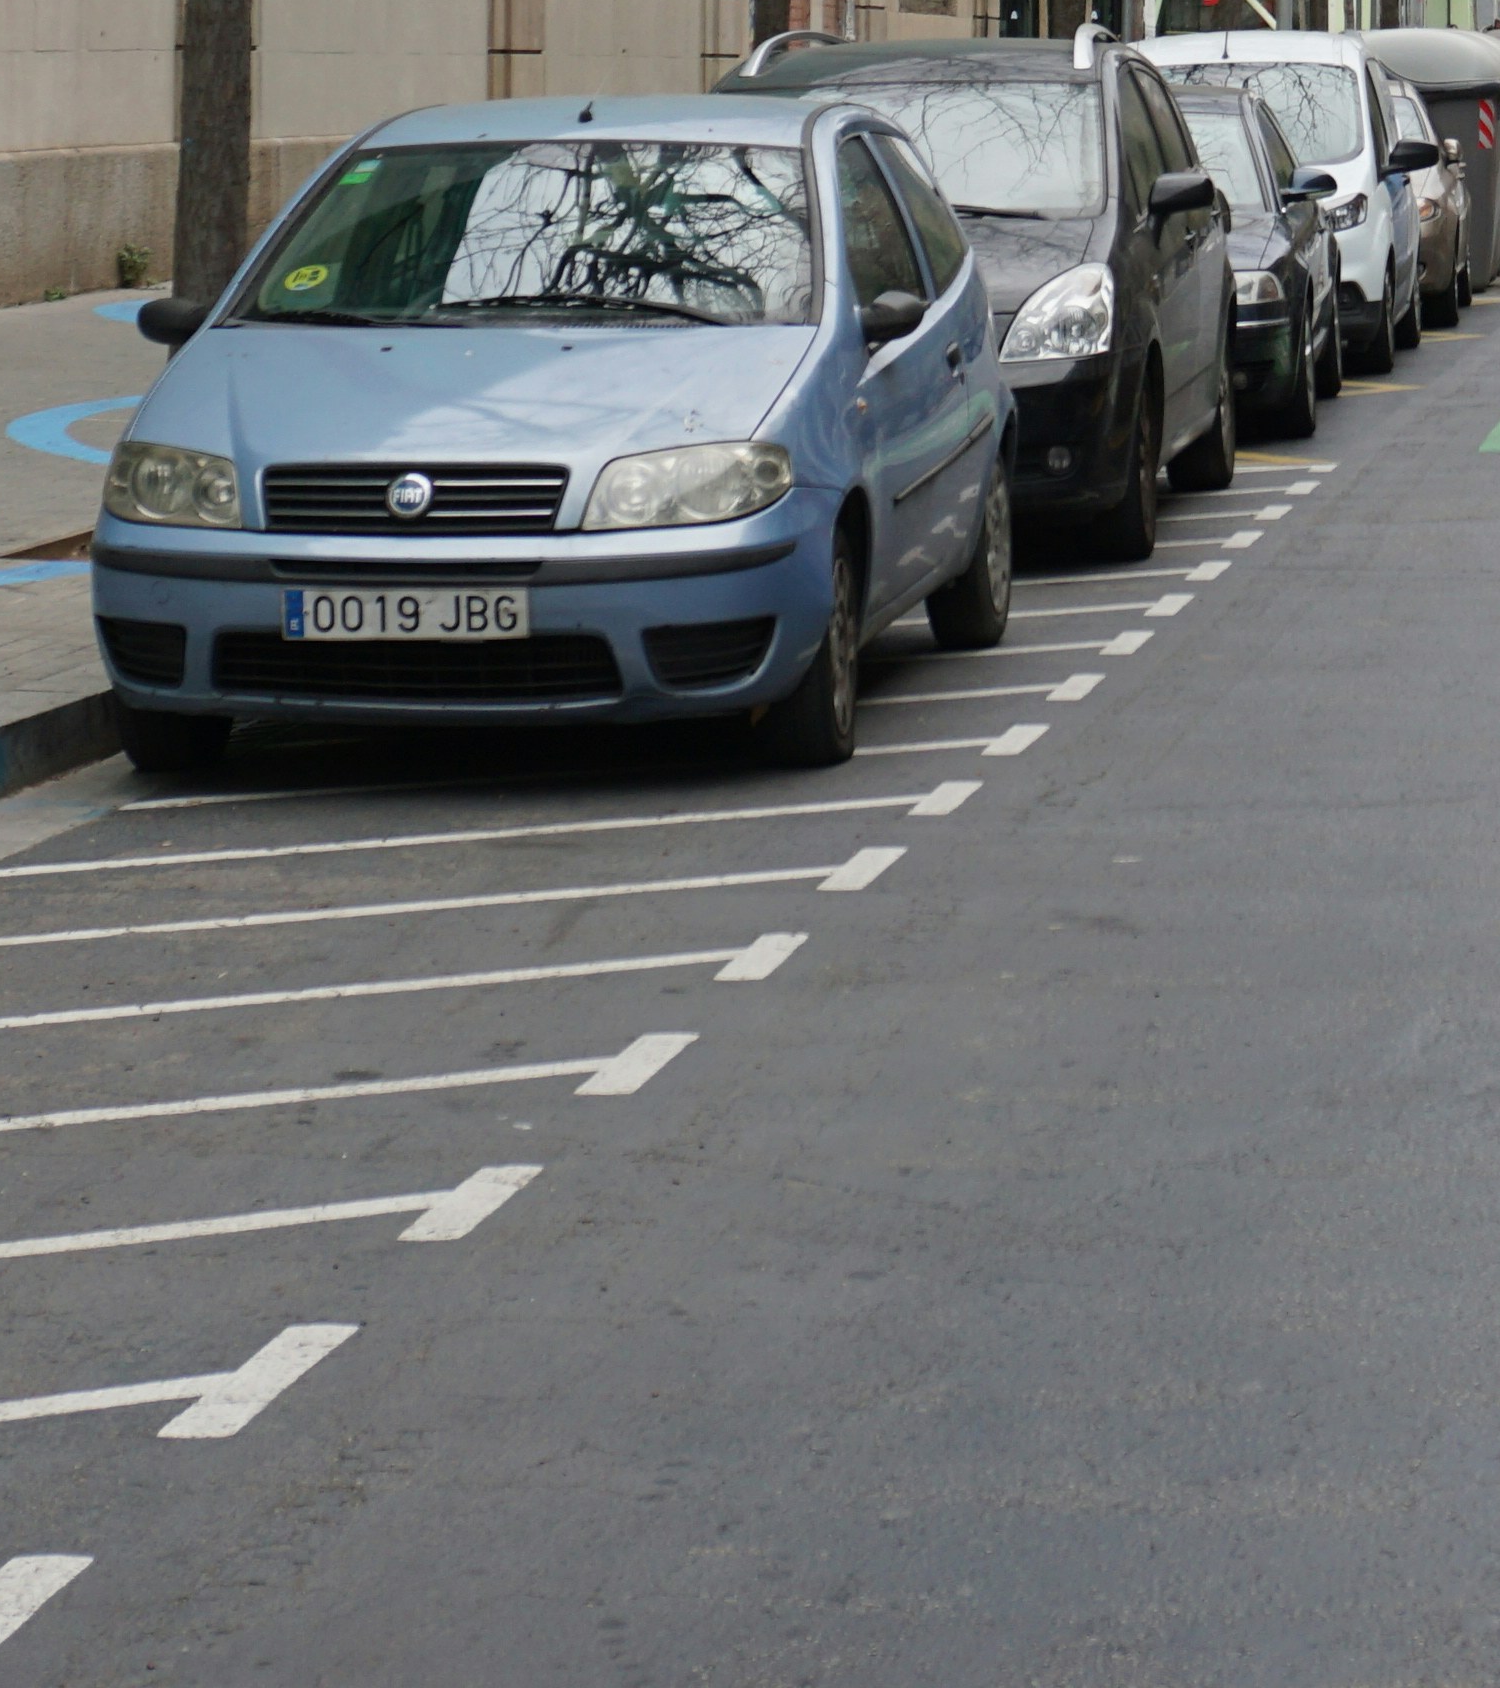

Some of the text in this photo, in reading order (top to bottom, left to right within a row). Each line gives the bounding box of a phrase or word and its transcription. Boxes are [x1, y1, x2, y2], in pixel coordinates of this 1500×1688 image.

[392, 486, 423, 504] FIAT
[312, 595, 518, 633] 0019 JBG
